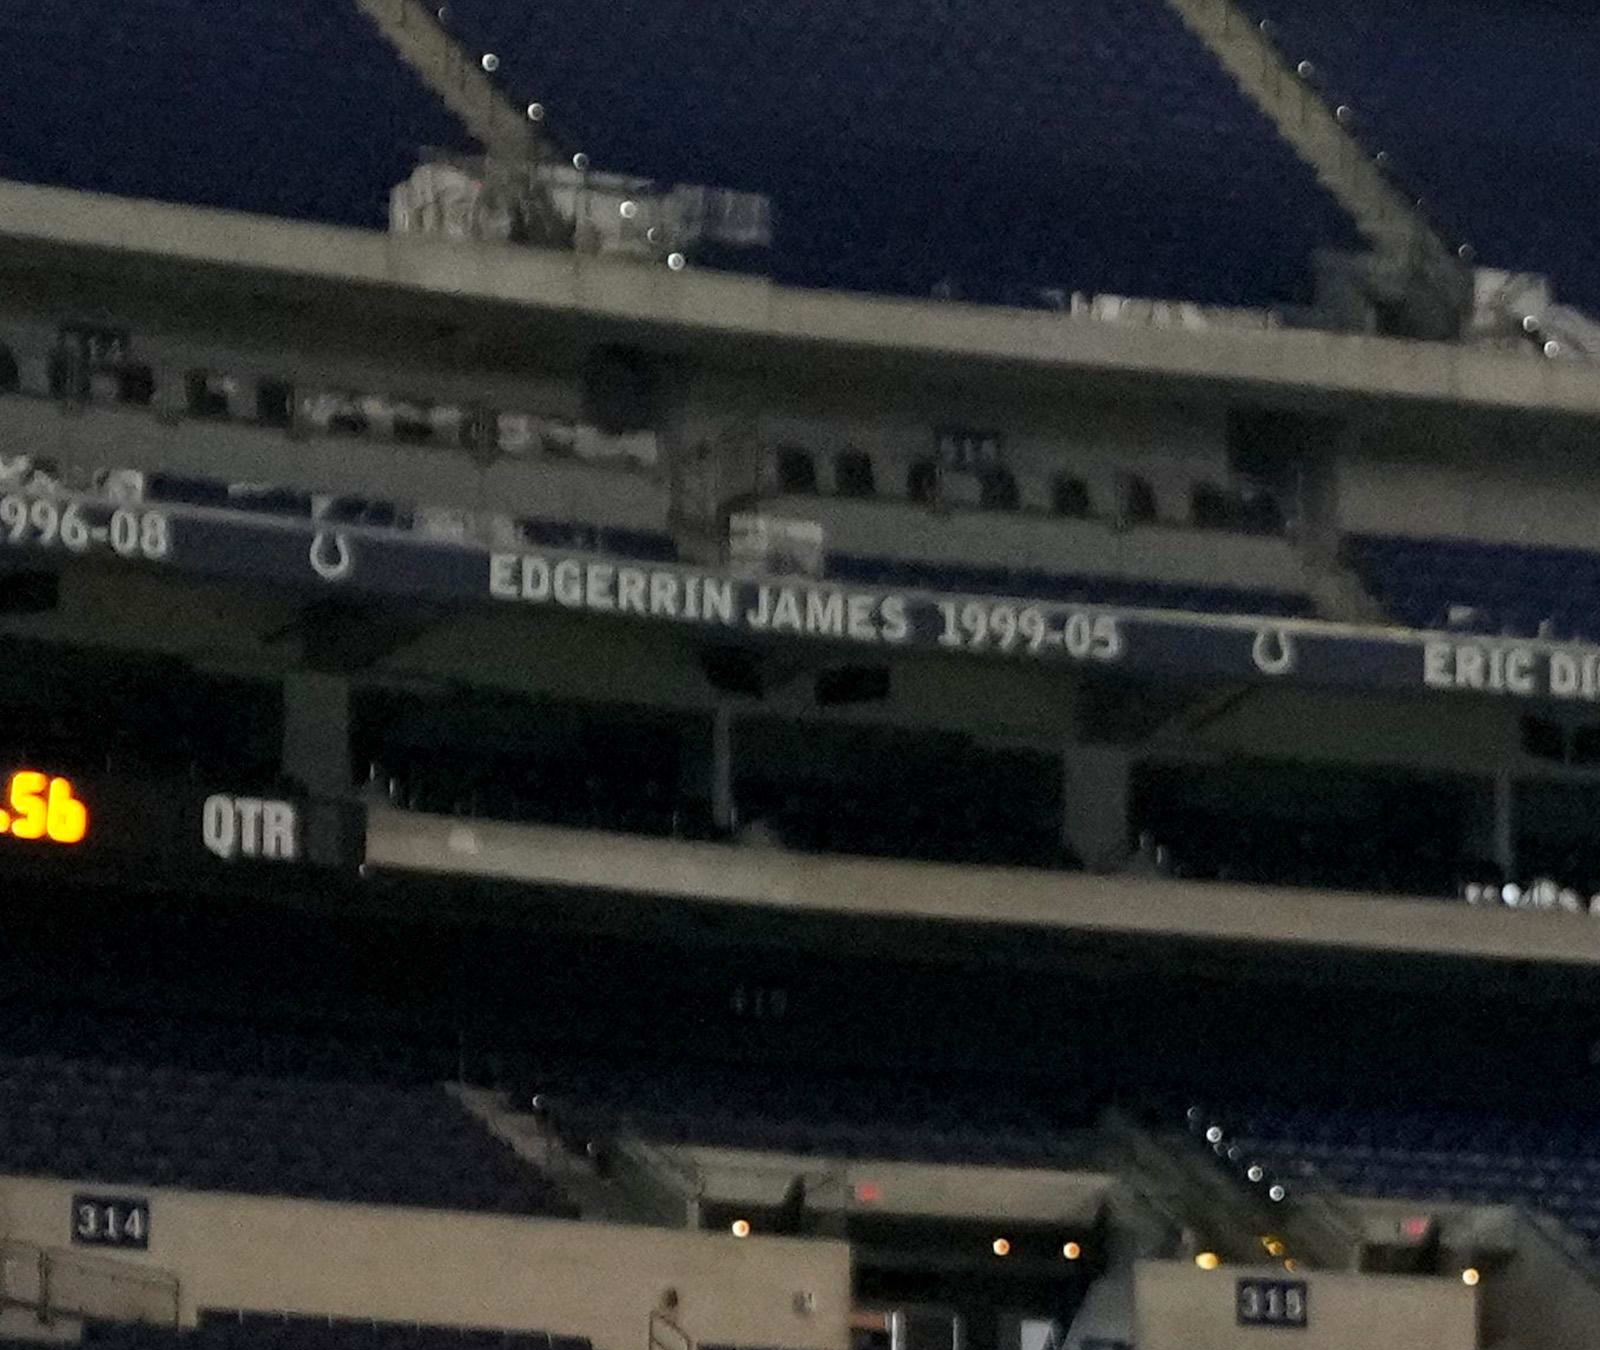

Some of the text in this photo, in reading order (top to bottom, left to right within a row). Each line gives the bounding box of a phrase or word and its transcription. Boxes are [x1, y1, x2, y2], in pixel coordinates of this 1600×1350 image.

[489, 552, 1122, 660] EDGERRIN JAMES 1999-05
[1423, 638, 1534, 693] ERIC
[203, 794, 296, 859] QTR
[78, 1200, 144, 1242] 314
